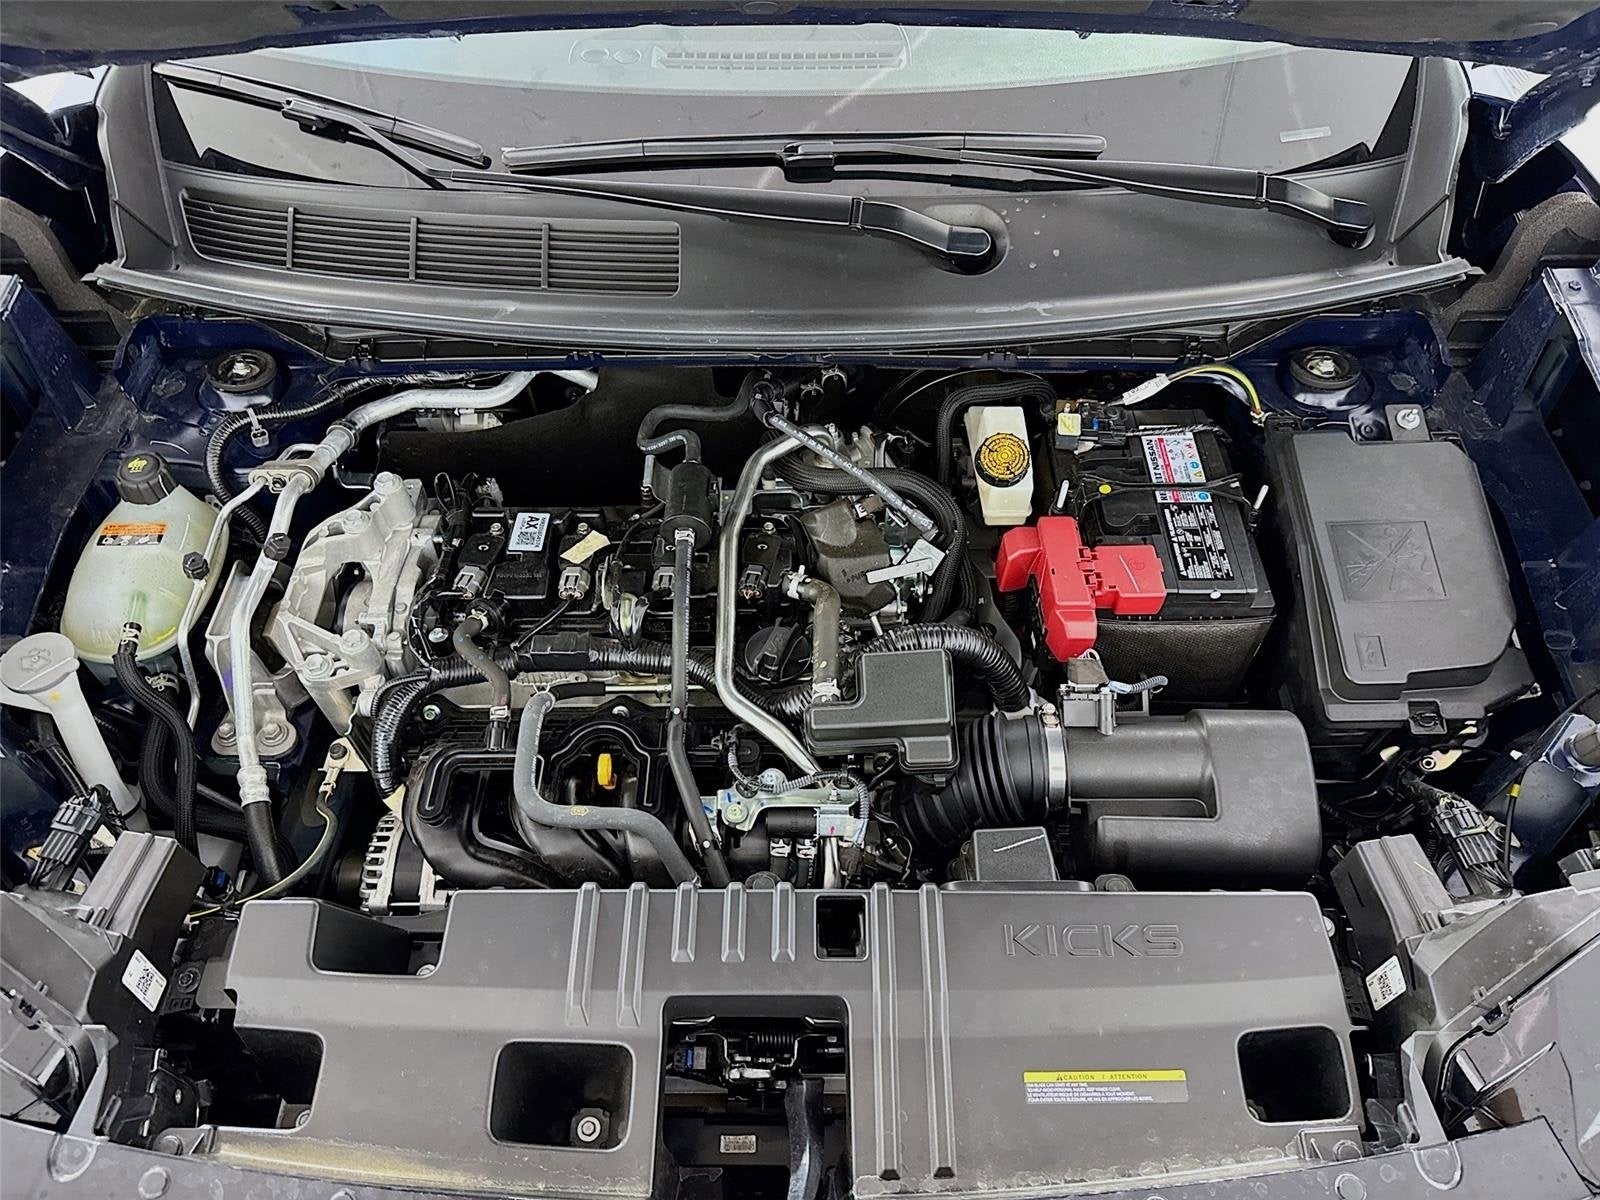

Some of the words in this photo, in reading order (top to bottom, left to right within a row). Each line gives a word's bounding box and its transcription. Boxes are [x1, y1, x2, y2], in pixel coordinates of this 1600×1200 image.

[1146, 439, 1160, 471] NISSAN
[525, 515, 540, 529] AX
[1003, 923, 1184, 957] KICKS
